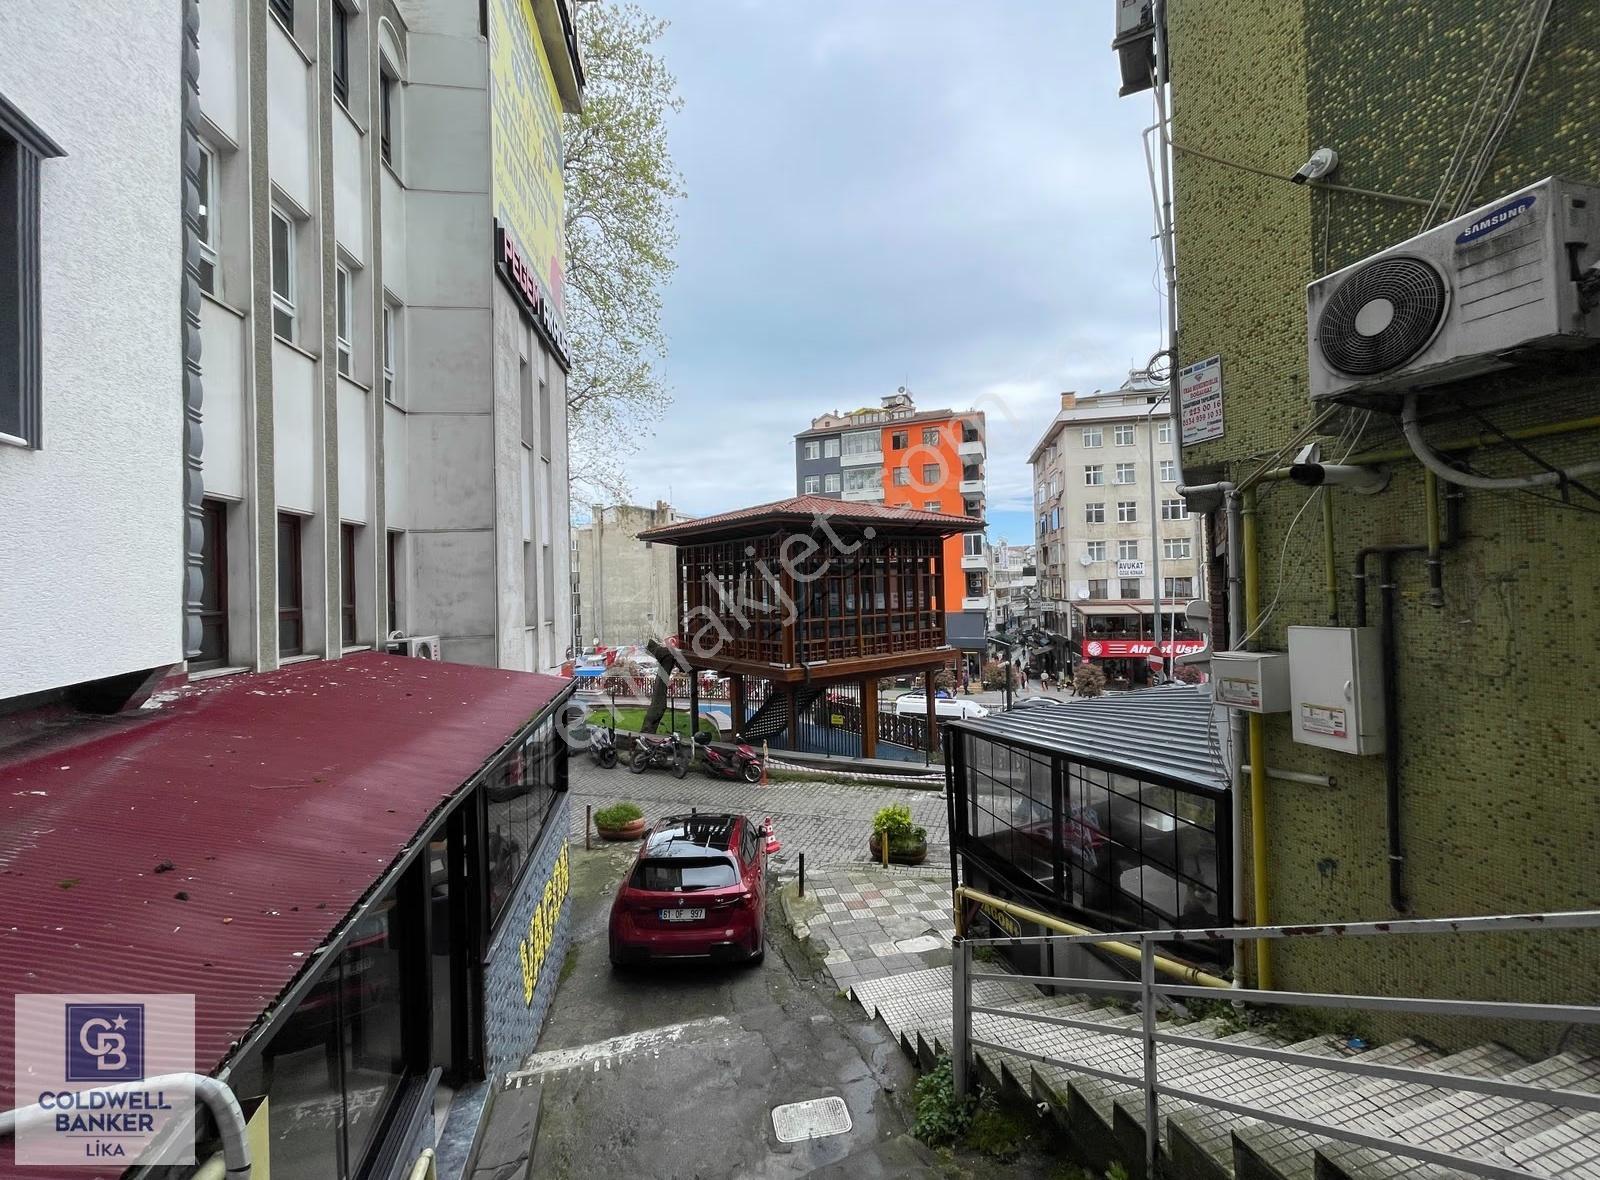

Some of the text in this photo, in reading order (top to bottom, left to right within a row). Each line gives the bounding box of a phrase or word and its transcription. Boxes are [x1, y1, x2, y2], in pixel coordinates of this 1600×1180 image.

[1464, 204, 1527, 237] SAMSUNG
[504, 233, 540, 316] PEGEM
[1119, 562, 1143, 570] AVUKAT
[1130, 645, 1171, 654] Ahet
